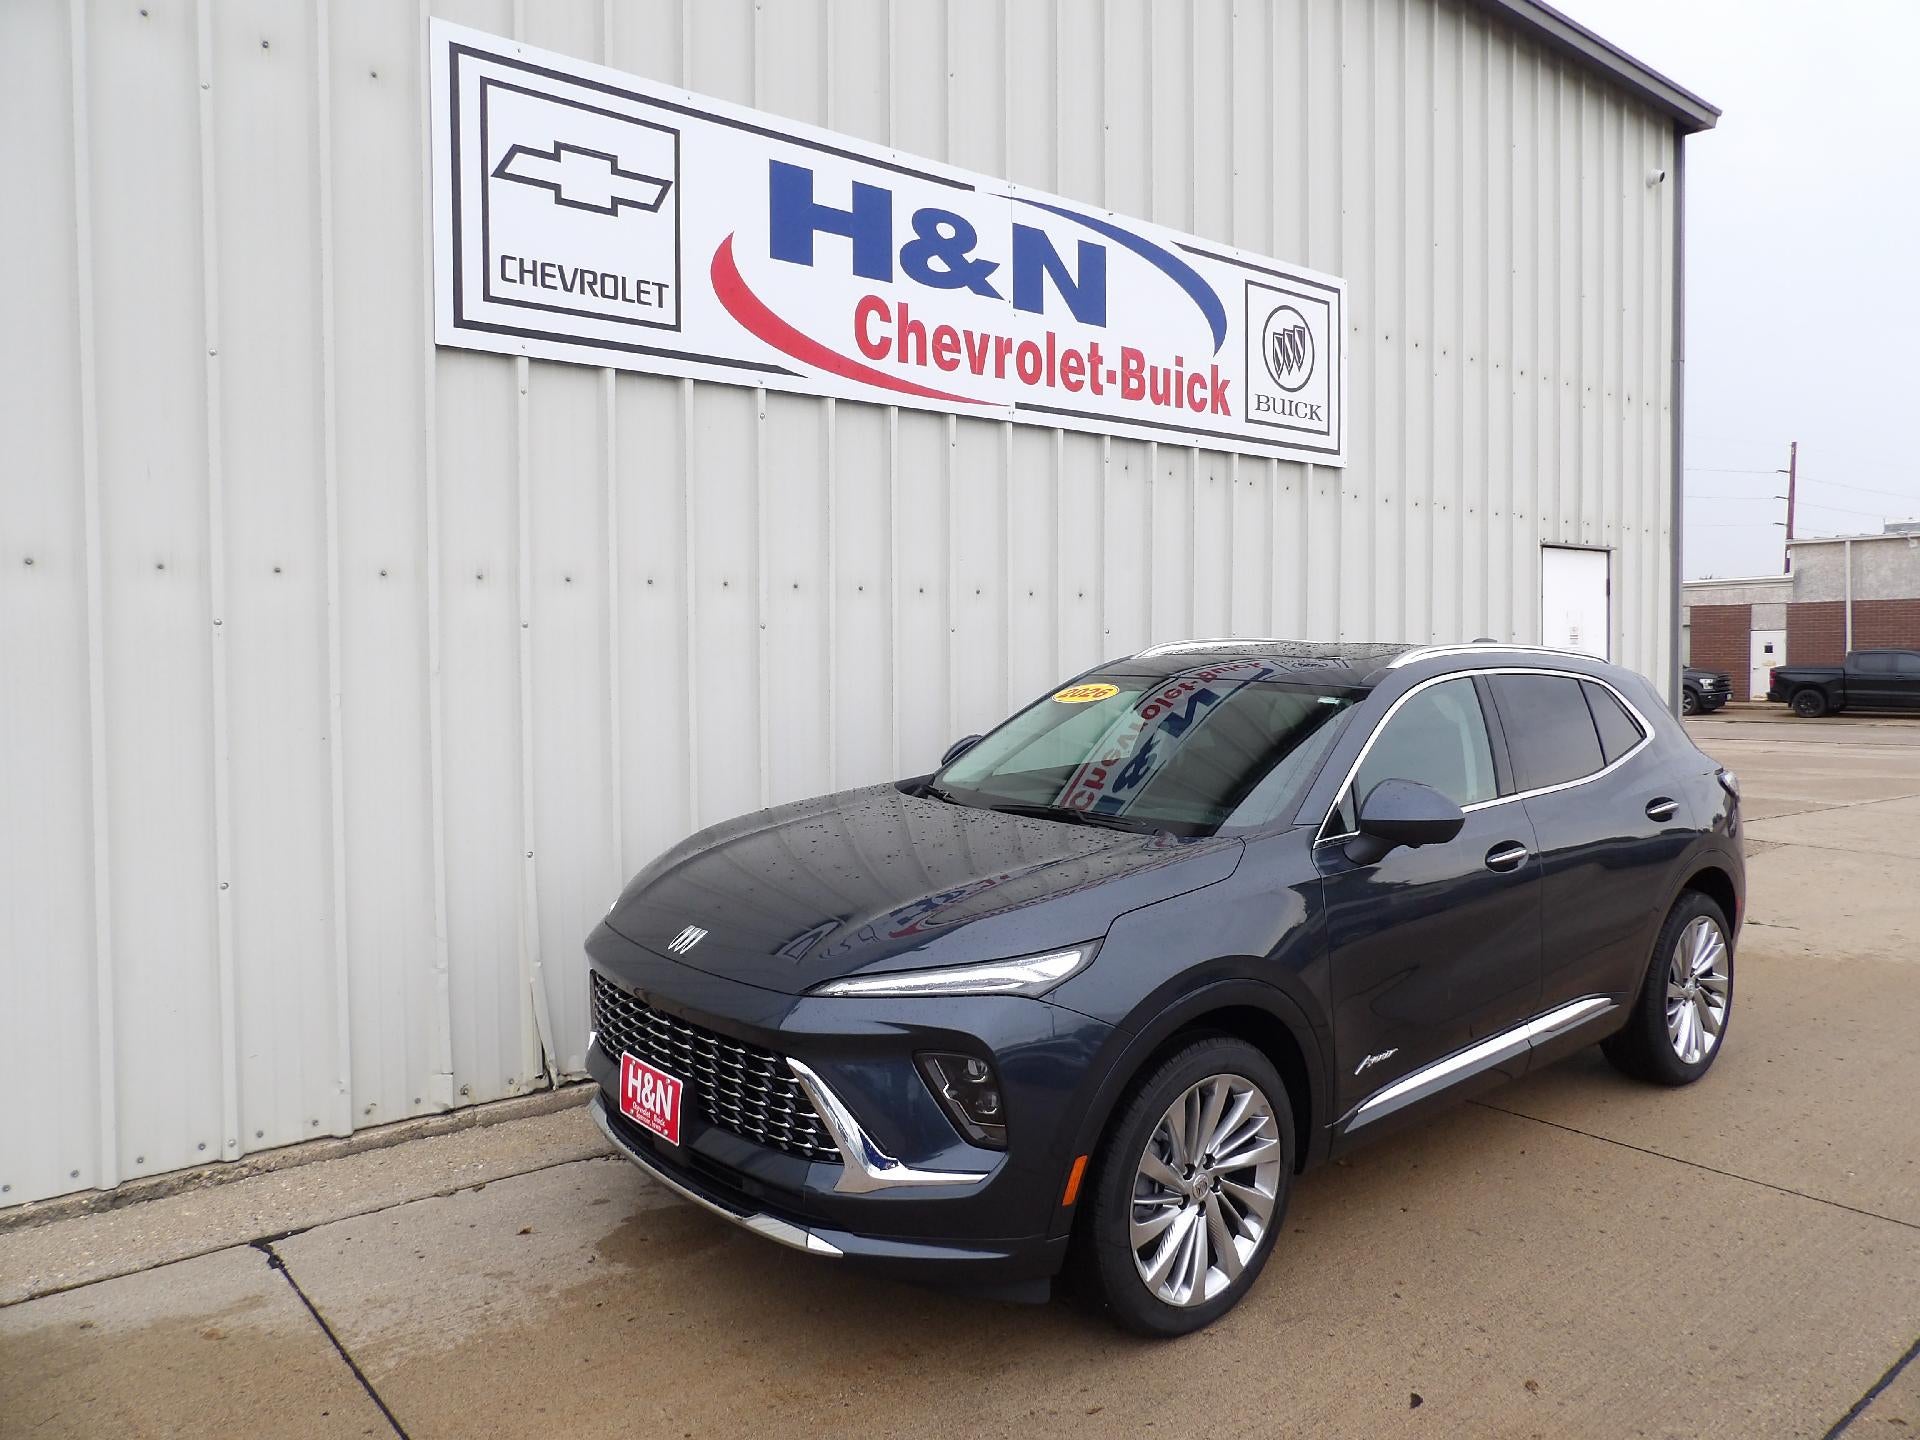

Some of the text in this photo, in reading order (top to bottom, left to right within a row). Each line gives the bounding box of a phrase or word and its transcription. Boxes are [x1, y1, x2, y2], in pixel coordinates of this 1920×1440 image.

[769, 158, 1107, 329] H&N
[500, 254, 670, 310] CHEVROLET
[853, 294, 1232, 418] Chevrolet-Buick
[1254, 393, 1323, 422] BUICK
[627, 1063, 673, 1121] H&N
